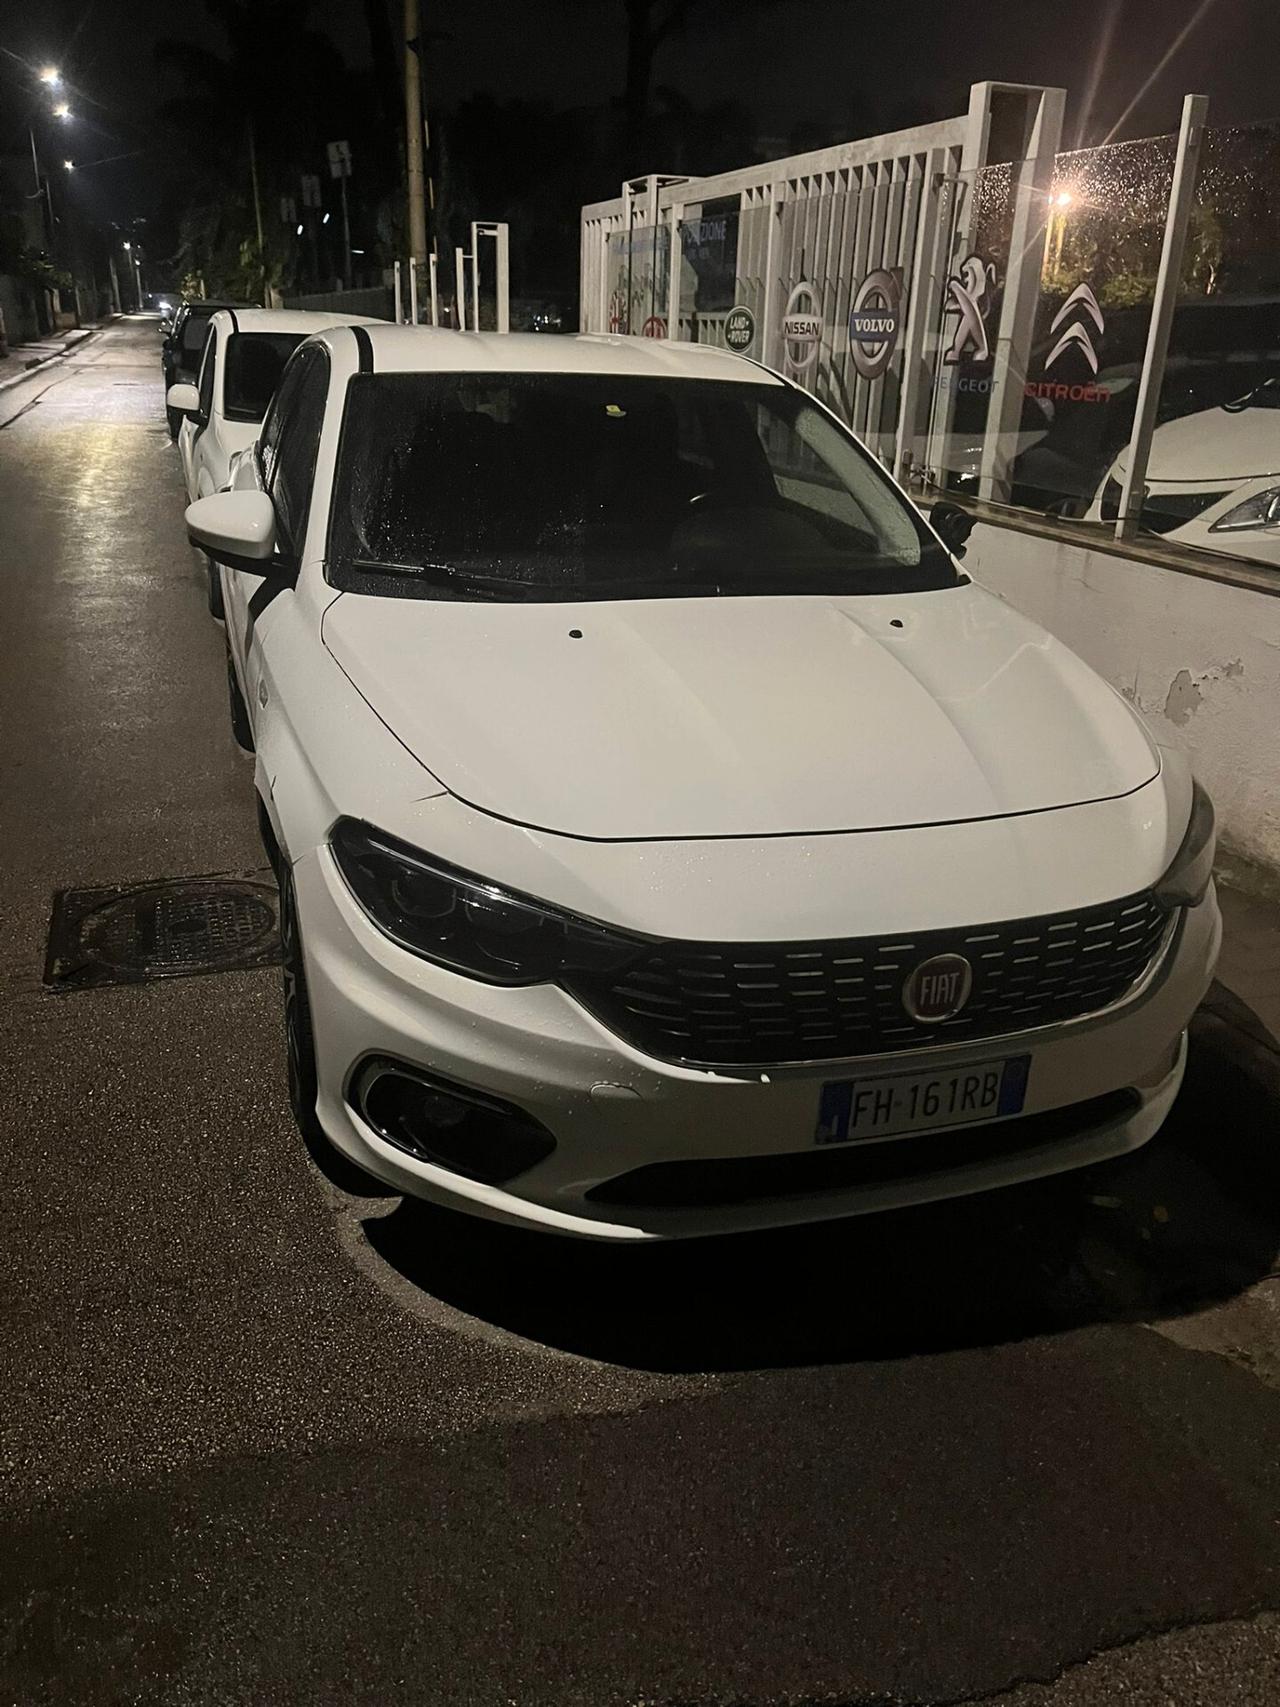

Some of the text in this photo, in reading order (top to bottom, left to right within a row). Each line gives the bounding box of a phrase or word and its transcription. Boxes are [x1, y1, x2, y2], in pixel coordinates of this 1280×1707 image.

[784, 321, 819, 336] NISSAN
[854, 318, 895, 333] VOLVO
[928, 376, 999, 393] PEGEOT
[919, 972, 961, 1007] FIAT
